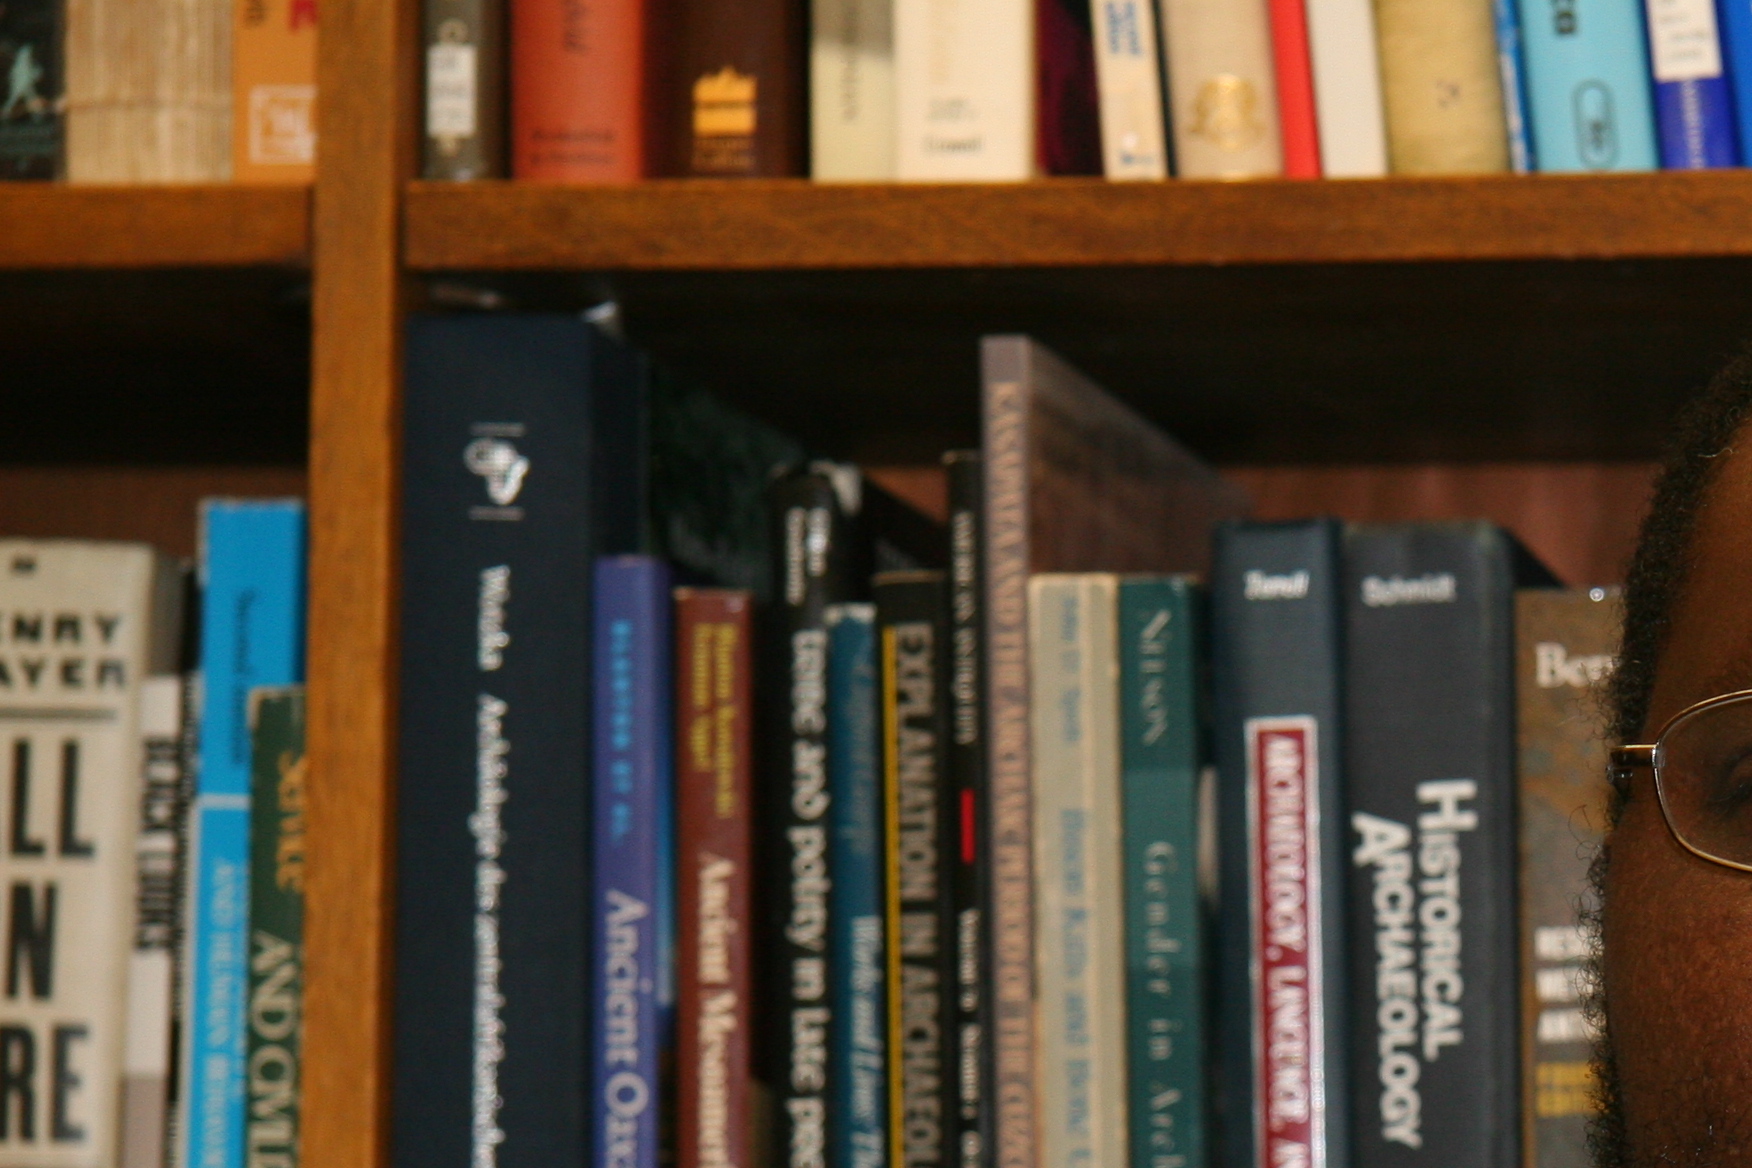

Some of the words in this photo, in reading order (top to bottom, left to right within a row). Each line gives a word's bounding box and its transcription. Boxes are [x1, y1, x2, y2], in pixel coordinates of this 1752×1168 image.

[0, 612, 121, 645] NRY
[996, 556, 1028, 627] AND
[997, 631, 1029, 689] THE
[1138, 608, 1173, 746] NELSON
[0, 738, 95, 858] LL
[790, 739, 831, 821] and
[896, 621, 938, 900] EXPLANATION
[210, 858, 238, 928] AND
[785, 826, 829, 952] polity
[1264, 733, 1306, 961] ARCHAEOLOGY,
[7, 881, 58, 1000] N
[699, 856, 738, 984] Ancient
[851, 915, 882, 993] Works
[899, 912, 940, 957] IN
[1144, 840, 1183, 997] Gender
[1415, 779, 1480, 1061] HISTORICAL
[206, 934, 236, 1048] HUMAN
[251, 930, 295, 1037] AND
[605, 889, 653, 1066] Ancient
[790, 957, 827, 999] in
[851, 998, 883, 1047] and
[1351, 811, 1425, 1149] ARCHAEOLOGY
[790, 1008, 829, 1089] late
[1148, 1018, 1181, 1061] in
